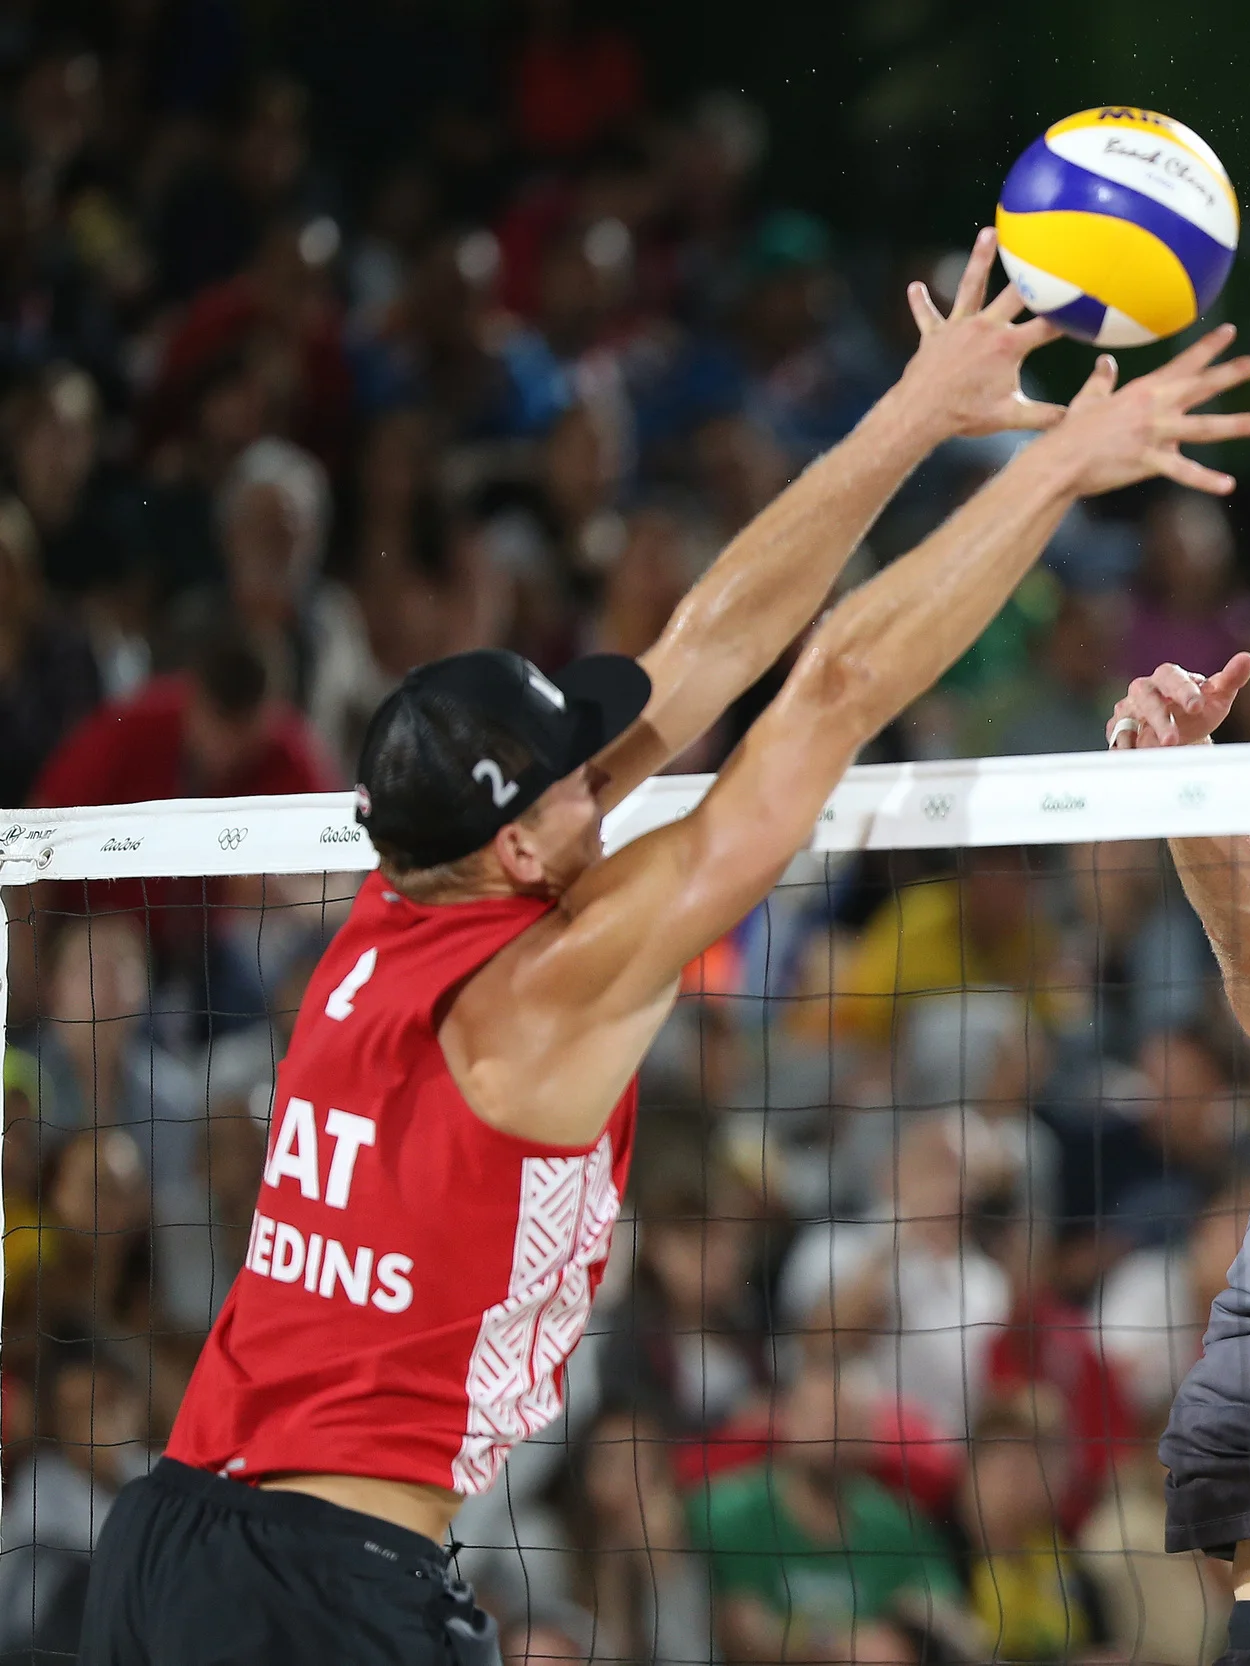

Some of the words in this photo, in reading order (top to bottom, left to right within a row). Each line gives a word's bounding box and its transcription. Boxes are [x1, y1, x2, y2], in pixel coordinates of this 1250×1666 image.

[472, 758, 520, 808] 2
[100, 836, 145, 852] Rio2016
[319, 825, 363, 843] Rio2016
[264, 1096, 376, 1210] AT
[246, 1208, 414, 1314] EDINS
